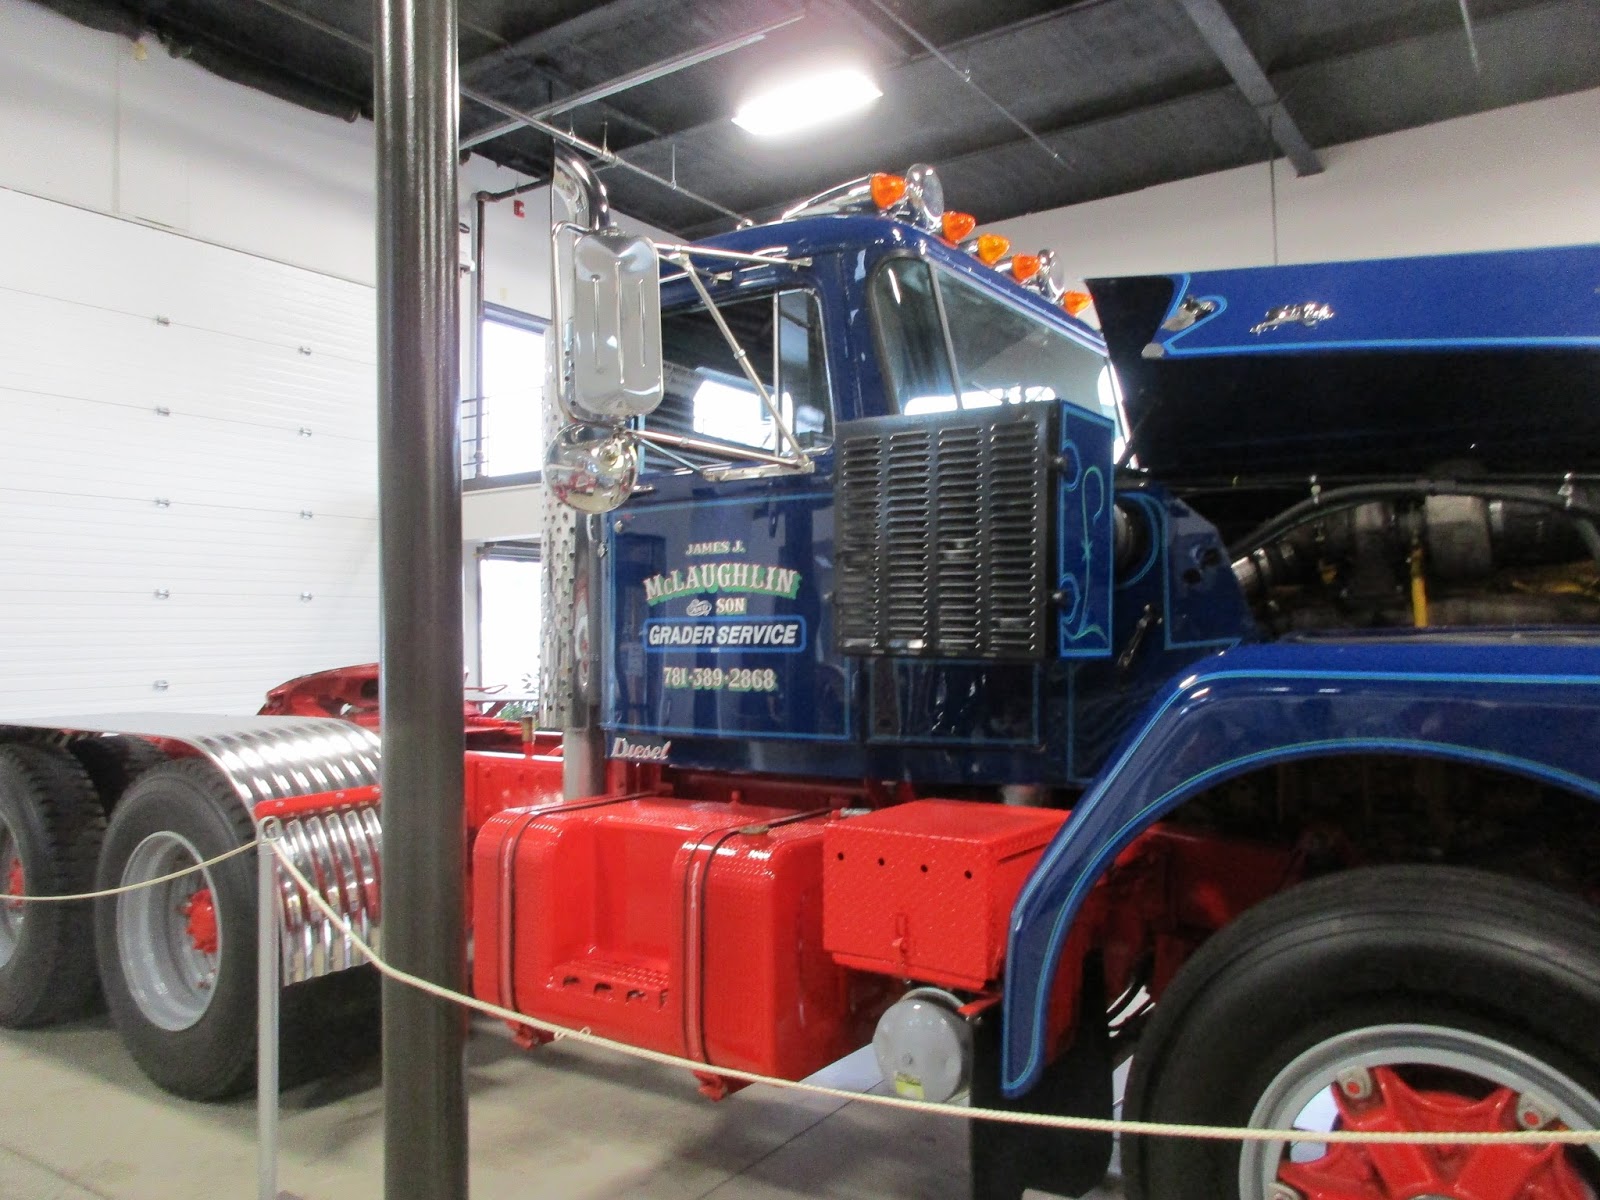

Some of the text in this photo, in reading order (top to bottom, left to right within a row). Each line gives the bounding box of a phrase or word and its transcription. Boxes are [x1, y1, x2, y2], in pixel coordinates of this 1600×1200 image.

[685, 540, 746, 556] JAMES J.
[715, 597, 747, 615] SON
[649, 624, 798, 645] GRADER SERVICE
[610, 737, 672, 760] Diesel
